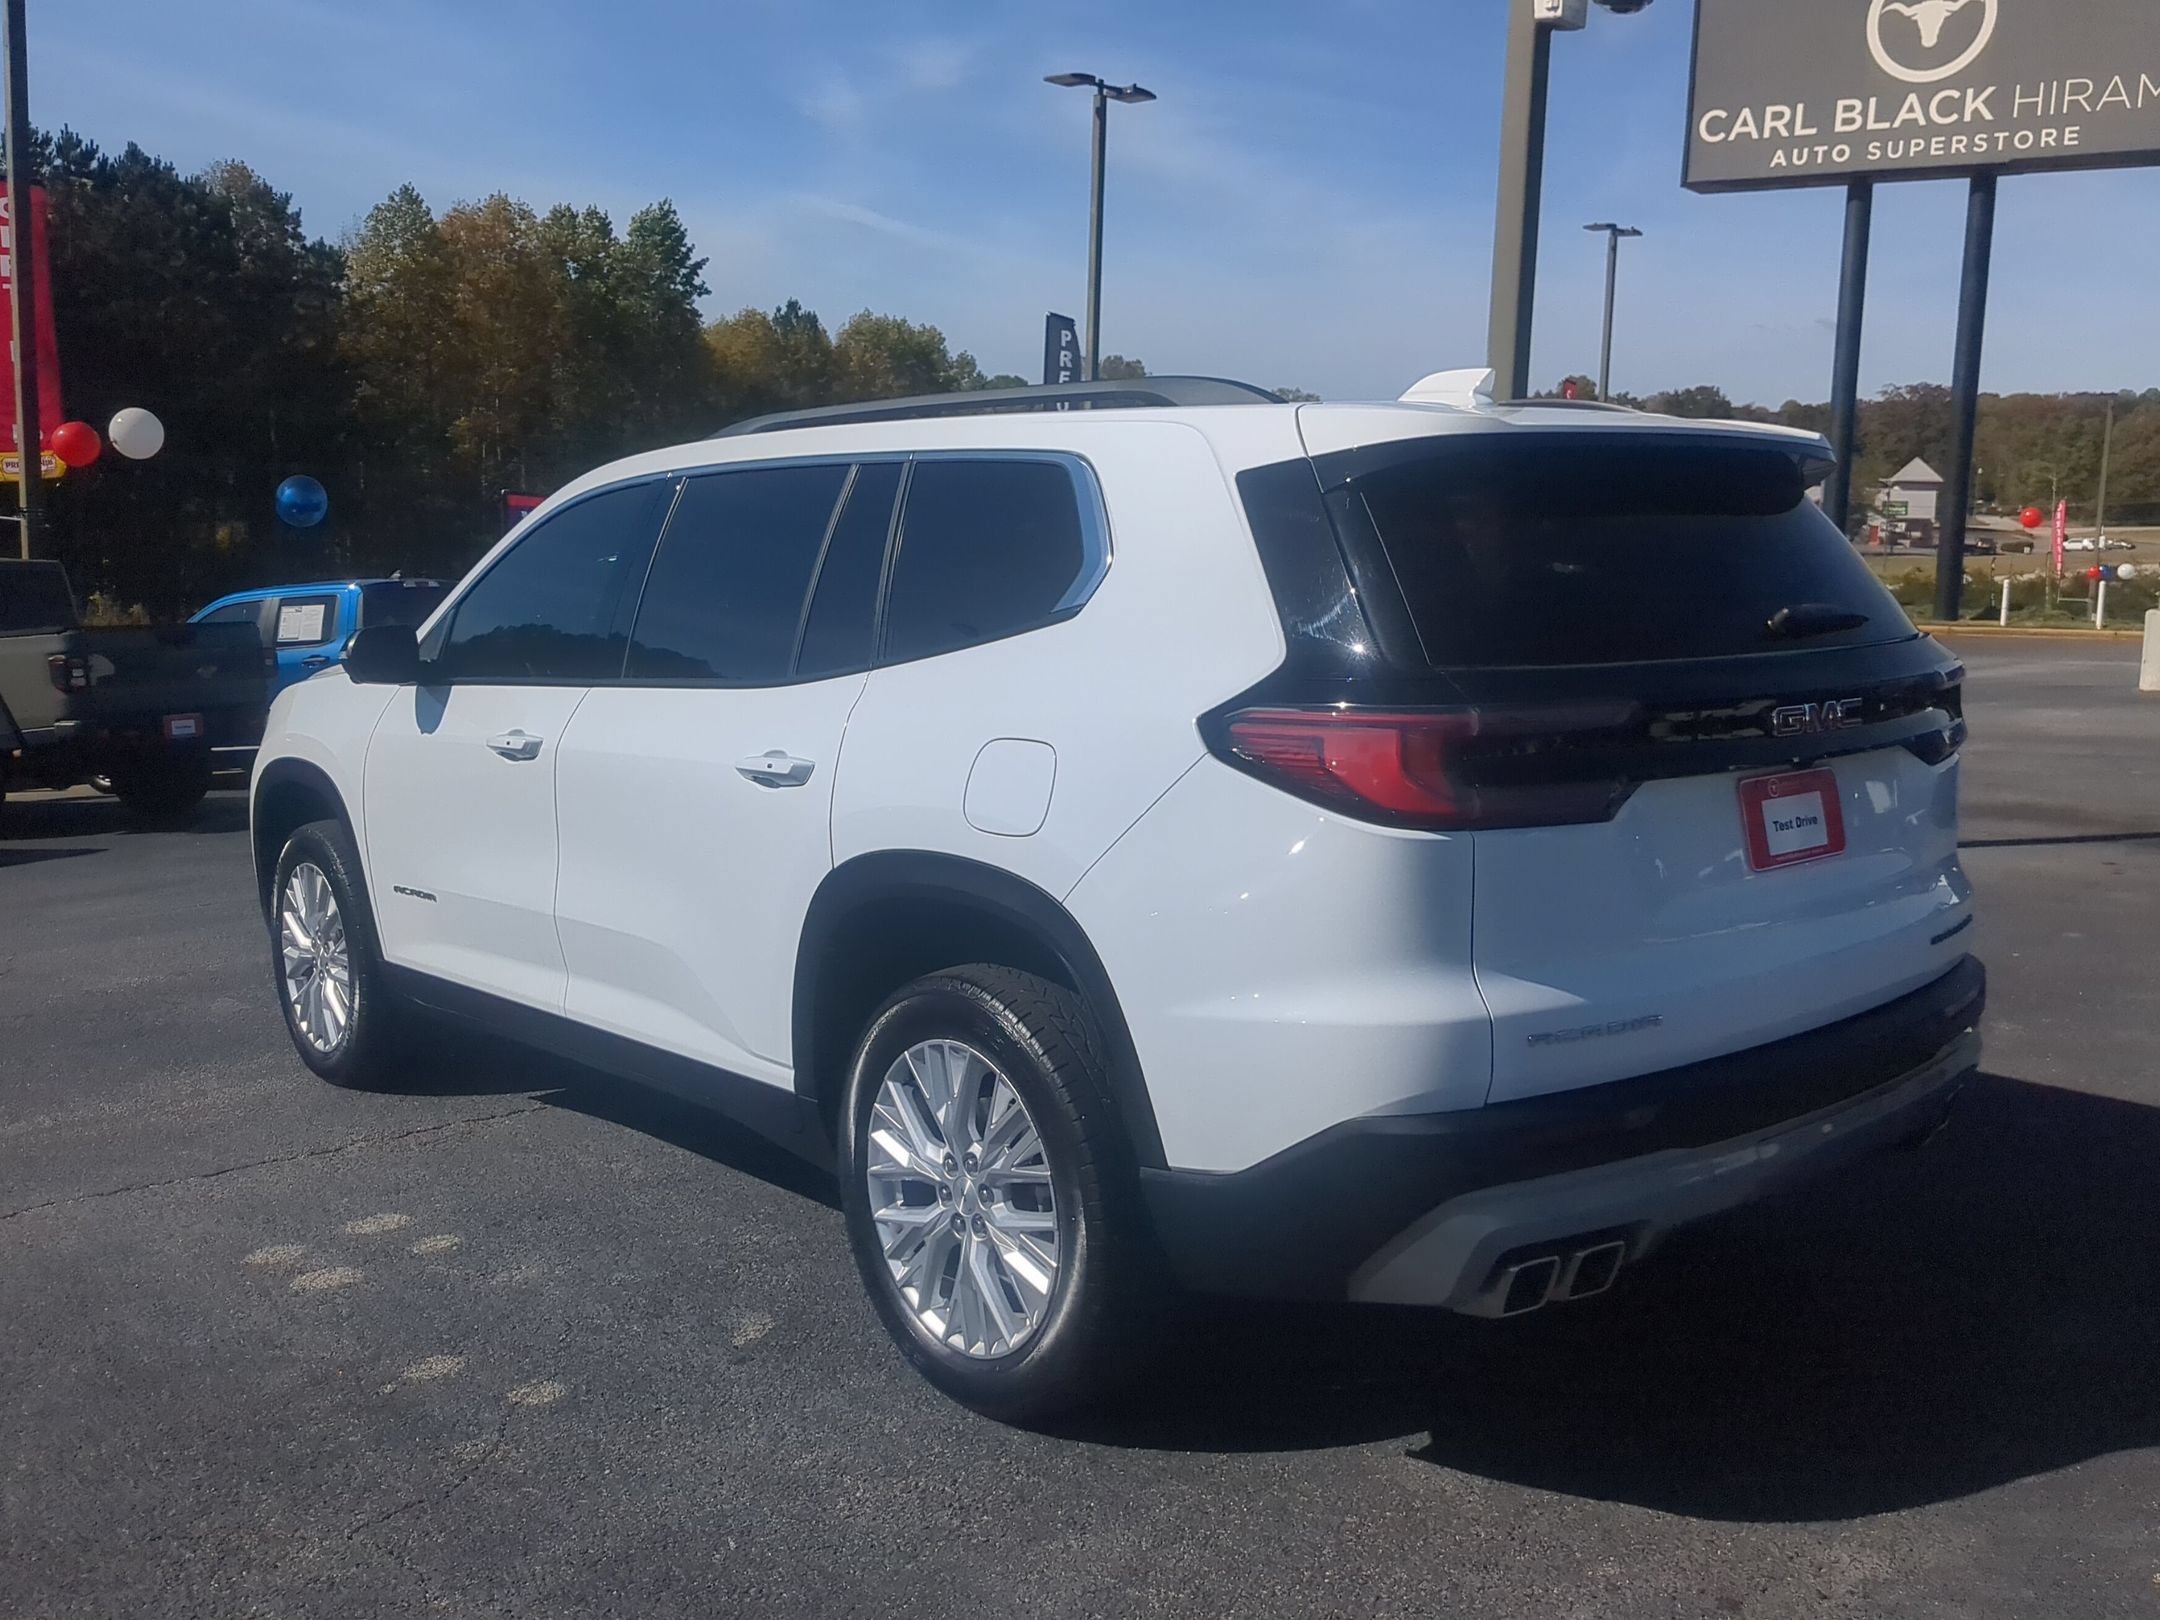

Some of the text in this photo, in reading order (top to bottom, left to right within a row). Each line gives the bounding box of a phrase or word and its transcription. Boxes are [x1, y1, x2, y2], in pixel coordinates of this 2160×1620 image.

[1699, 73, 2160, 143] CARL BLACK HIRAM
[1769, 125, 2081, 168] AUTO SUPERSTORE
[1772, 697, 1864, 737] GMC
[1772, 816, 1818, 833] Test Drive
